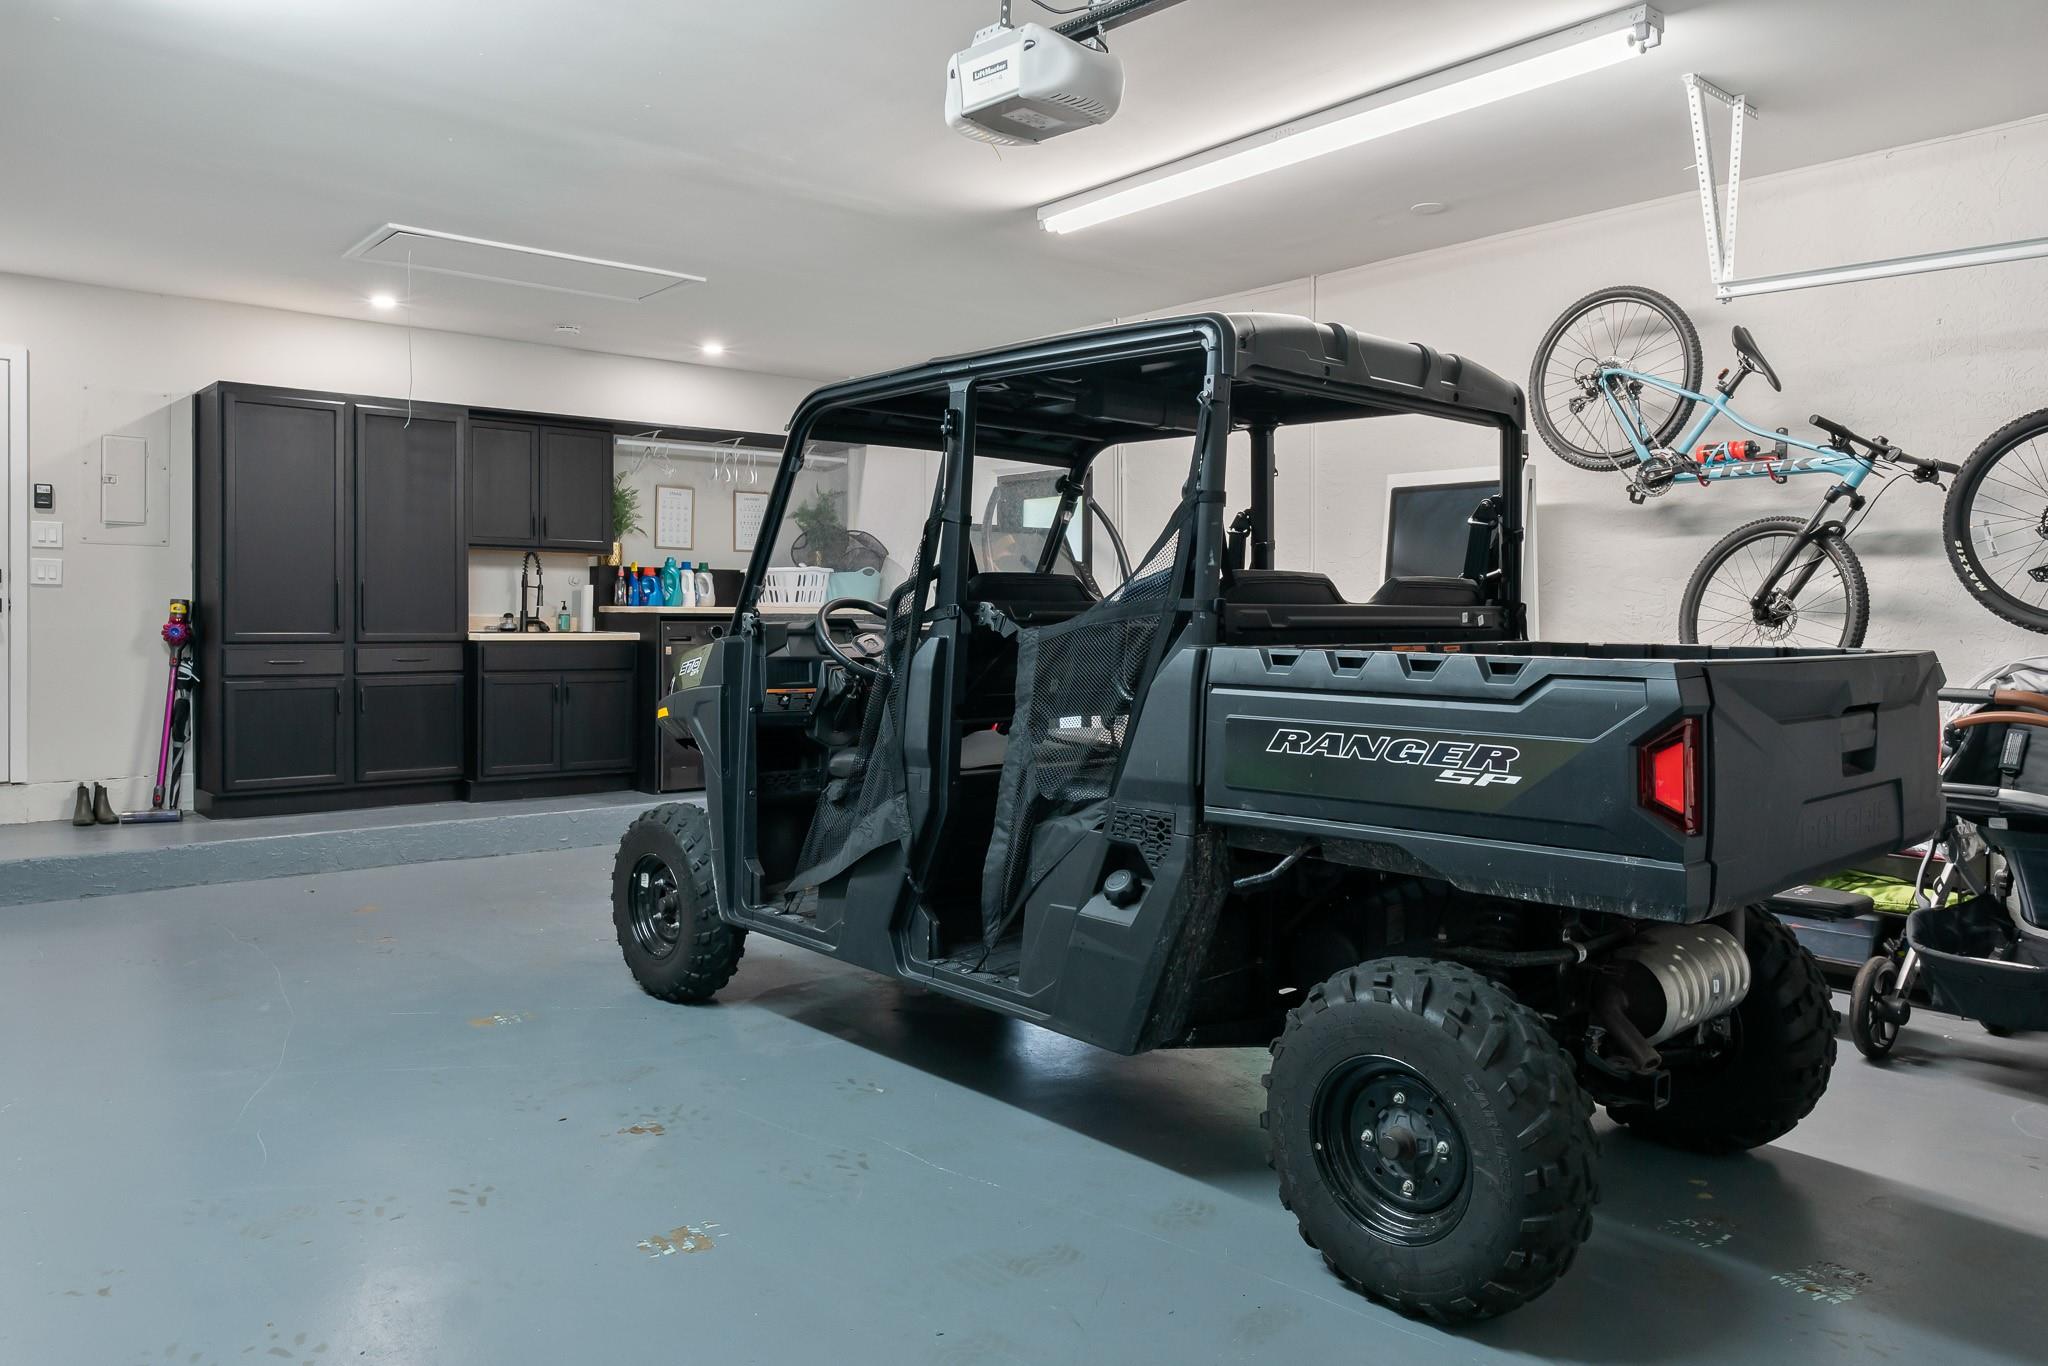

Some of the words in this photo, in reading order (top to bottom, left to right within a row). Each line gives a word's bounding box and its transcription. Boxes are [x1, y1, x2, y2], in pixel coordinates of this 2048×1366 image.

[1701, 456, 1816, 479] TREK
[1954, 540, 1988, 591] MAXXIS
[1266, 729, 1520, 772] RANGER
[1435, 769, 1522, 786] SP
